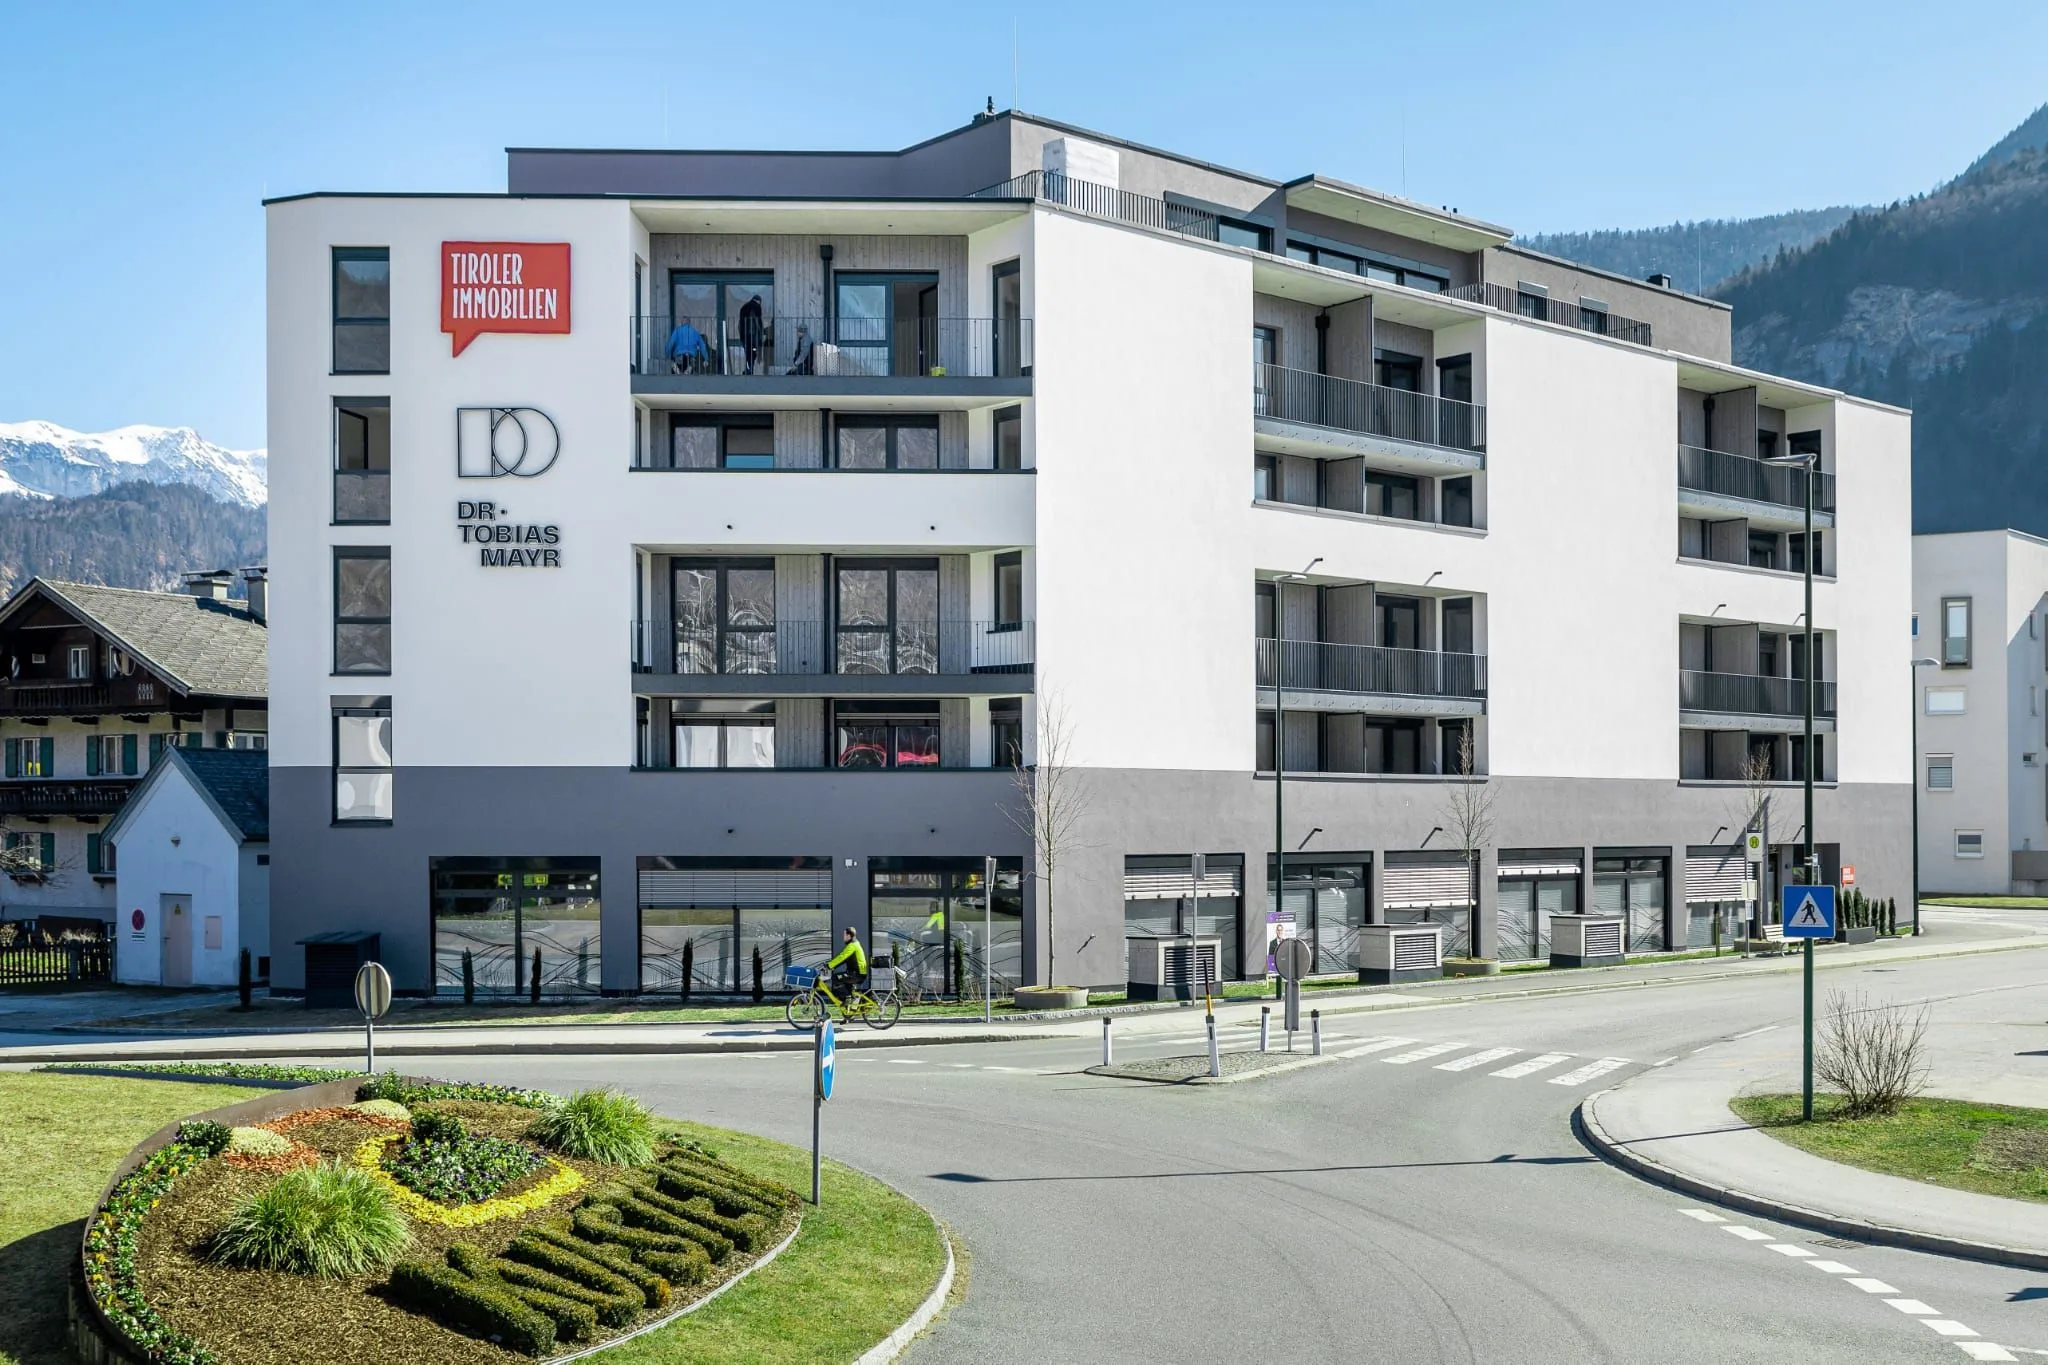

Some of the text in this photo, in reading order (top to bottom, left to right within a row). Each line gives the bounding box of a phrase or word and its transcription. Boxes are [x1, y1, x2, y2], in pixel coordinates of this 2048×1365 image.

[451, 252, 523, 285] TIROLER
[453, 287, 557, 320] IMMOBILIEN
[457, 524, 561, 545] TOBIAS
[480, 548, 562, 569] MAYR
